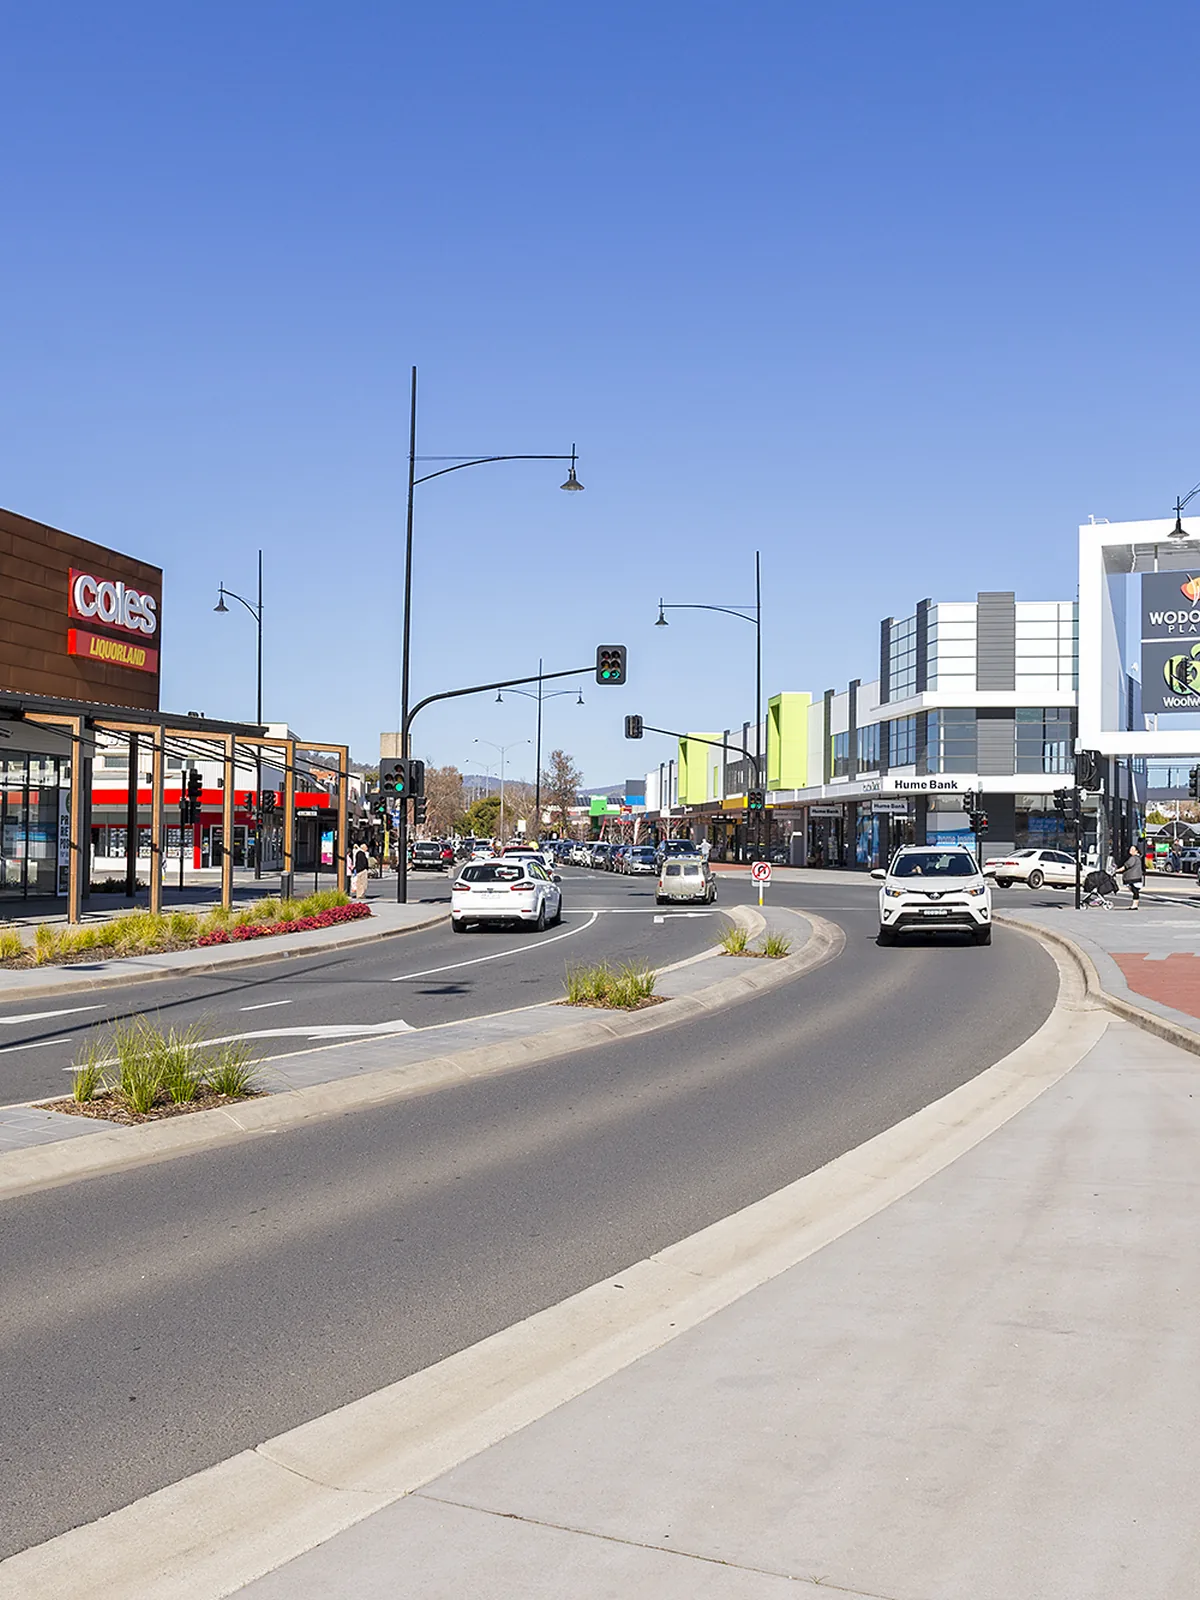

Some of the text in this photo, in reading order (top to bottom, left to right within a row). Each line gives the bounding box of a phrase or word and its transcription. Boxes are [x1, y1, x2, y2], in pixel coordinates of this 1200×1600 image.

[74, 575, 157, 635] coles
[89, 637, 145, 666] LIQUORLAND
[1163, 695, 1200, 707] Woolw
[895, 780, 958, 789] Hume Bank
